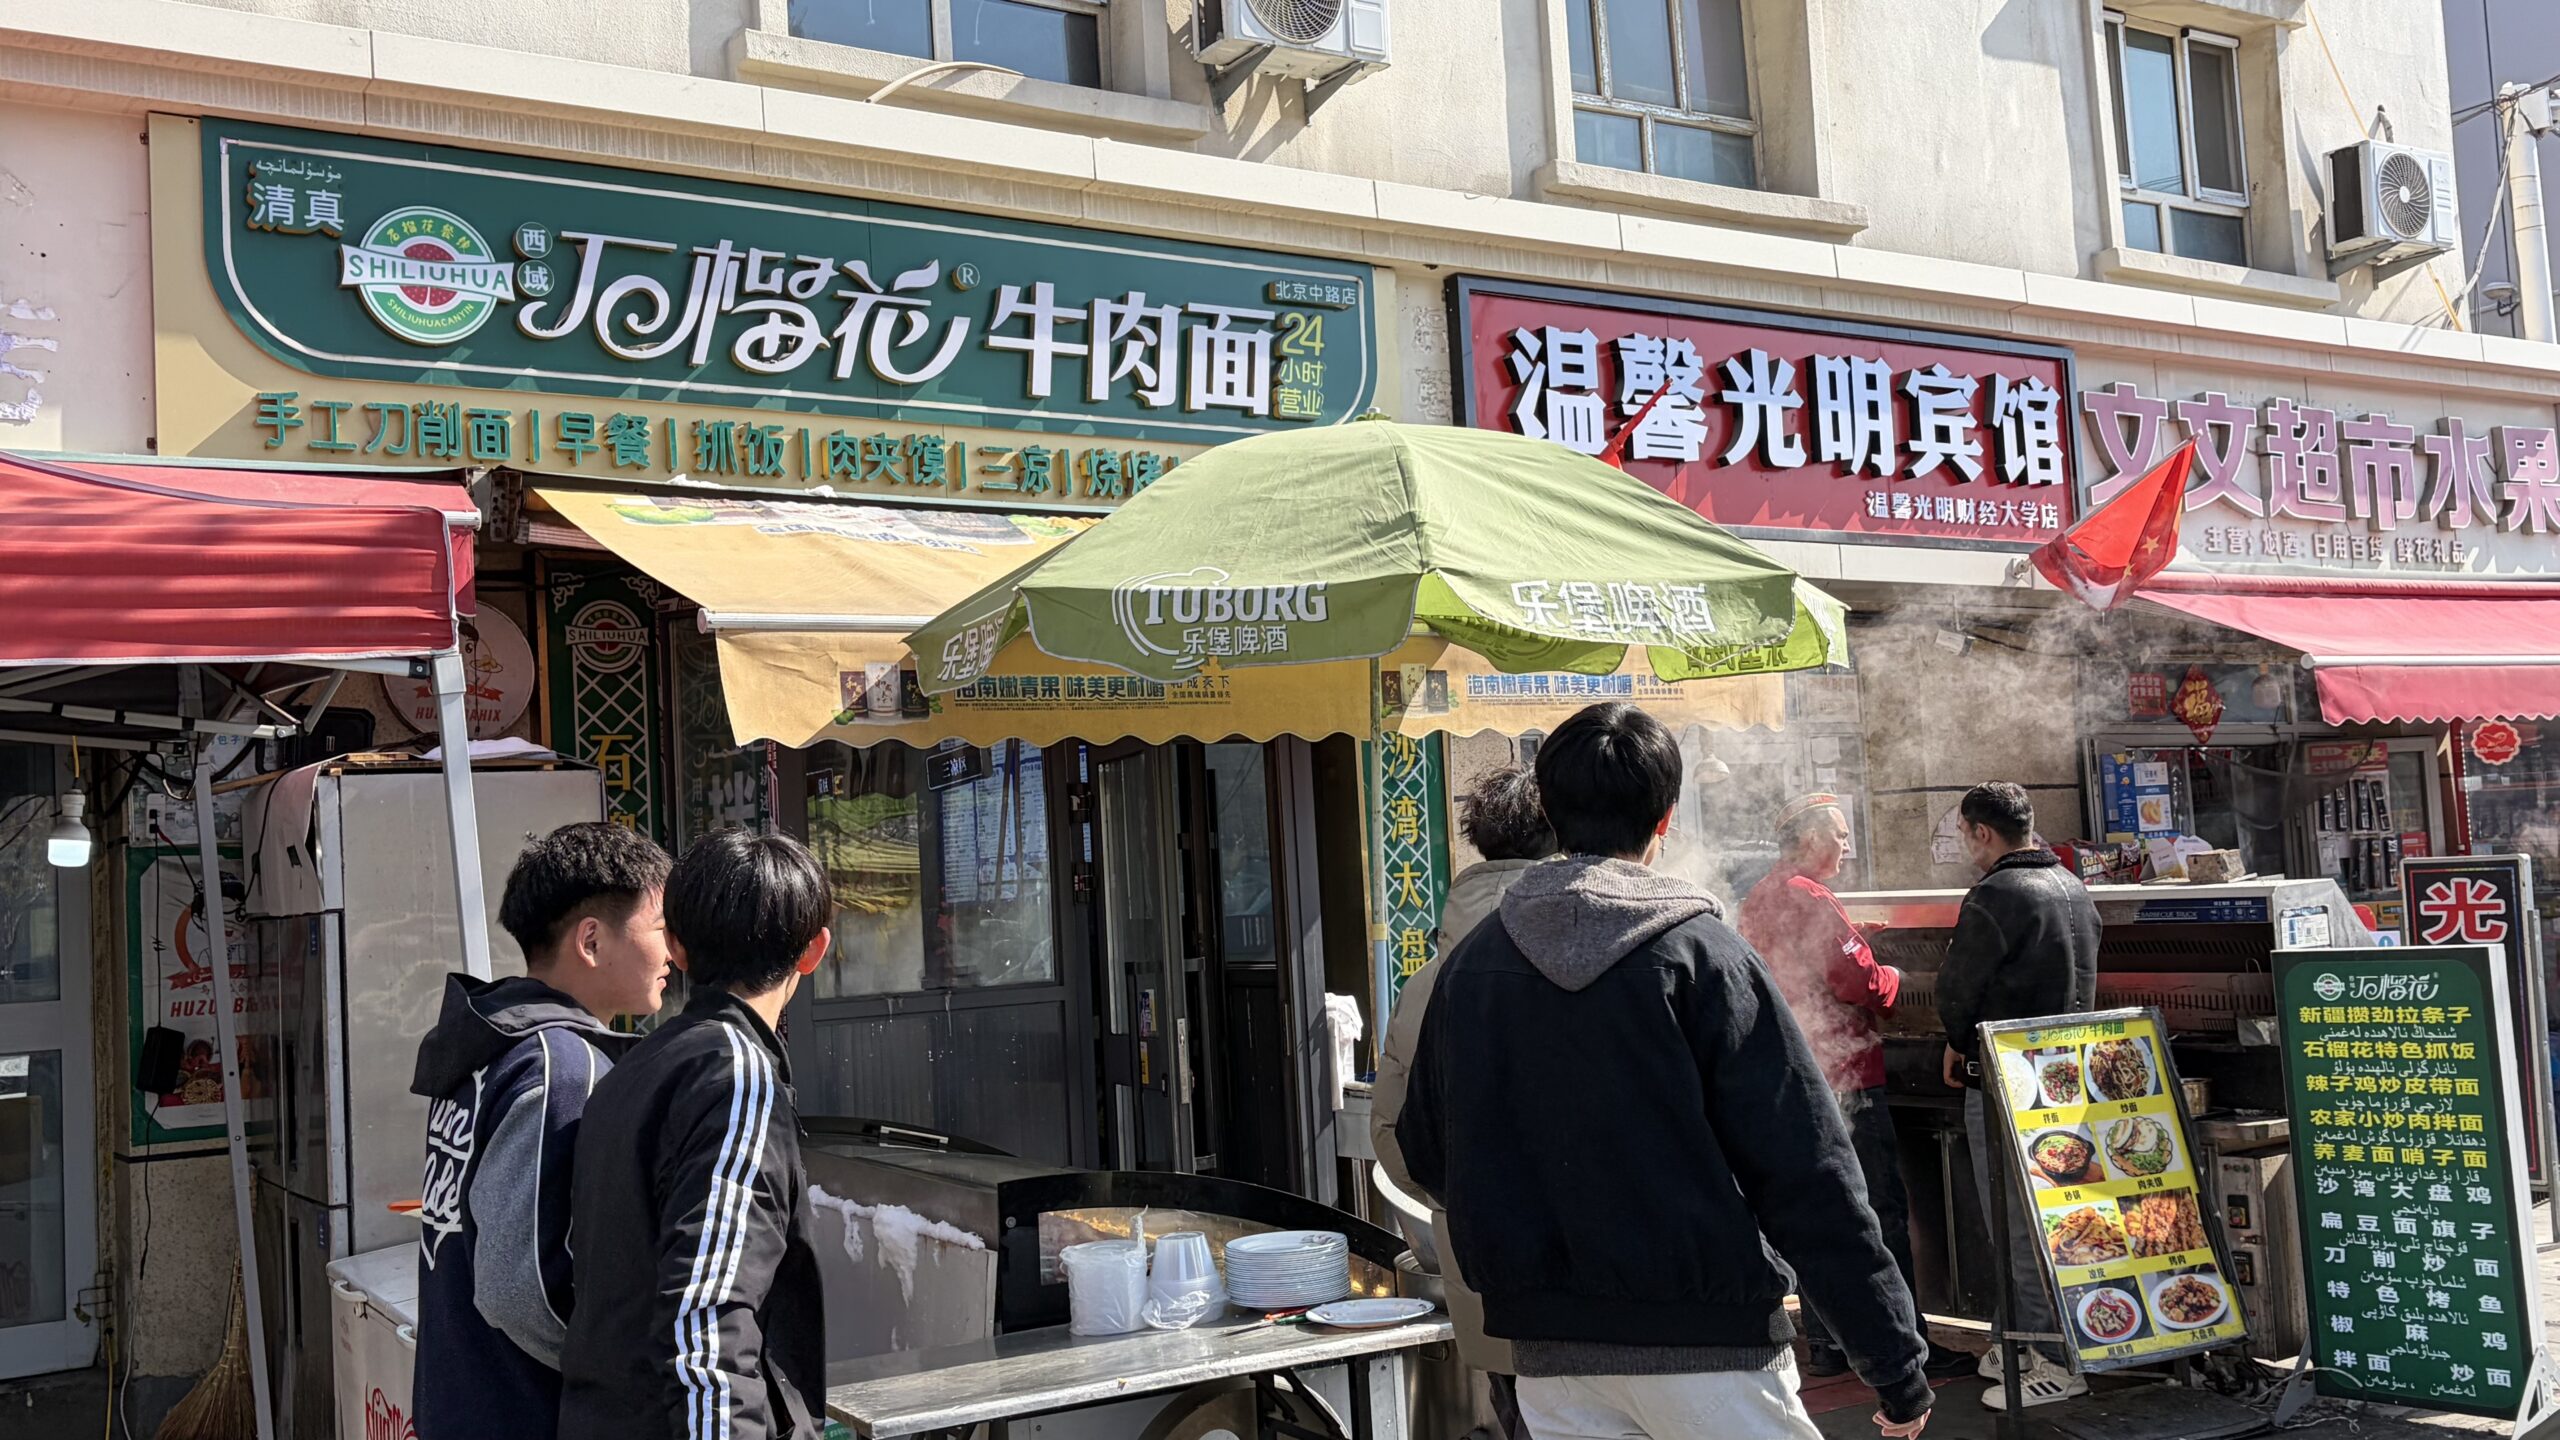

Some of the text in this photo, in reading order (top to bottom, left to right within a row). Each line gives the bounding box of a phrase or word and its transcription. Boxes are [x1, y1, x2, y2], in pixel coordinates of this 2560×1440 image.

[254, 182, 345, 231] 清真
[349, 254, 510, 292] SHILIUHUA
[521, 228, 549, 291] 西域
[1274, 279, 1357, 306] 北京中路店
[386, 298, 475, 328] SHILIUHUACANYIN
[516, 231, 971, 385] 石榴花
[985, 281, 1277, 416] 牛肉面
[1280, 312, 1326, 355] 24
[1279, 360, 1325, 387] 小时
[1279, 388, 1324, 417] 营业
[1510, 324, 2064, 485] 温馨光明宾馆
[255, 391, 512, 461] 手工刀削面
[556, 411, 652, 470] 早餐
[696, 420, 786, 477] 抓饭
[826, 429, 947, 486] 肉夹馍
[1084, 449, 1165, 498] 烧烤
[2083, 381, 2560, 534] 文文超市水果
[1866, 490, 2059, 530] 温馨光明财经大学店
[1140, 582, 1328, 624] TUBORG
[1511, 579, 1716, 634] 乐堡啤酒
[568, 629, 647, 643] SHILIUHUA
[1182, 624, 1288, 656] 乐堡啤酒
[1467, 674, 1550, 695] 海南嫩青果
[1553, 674, 1632, 695] 味美更耐嚼
[467, 708, 501, 722] AHIX
[2420, 877, 2508, 945] 光
[2303, 1041, 2475, 1059] 石榴花特色抓饭
[2305, 1075, 2480, 1096] 辣子鸡炒皮带面
[2310, 1110, 2483, 1132] 农家小炒肉拌面
[2316, 1178, 2493, 1204] 沙湾大盘鸡
[2321, 1212, 2496, 1240] 扁豆面旗子
[2324, 1247, 2499, 1278] 刀削炒面
[2327, 1281, 2504, 1314] 特色烤鱼
[2330, 1315, 2507, 1351] 椒麻鸡
[2333, 1350, 2512, 1388] 拌面 炒面
